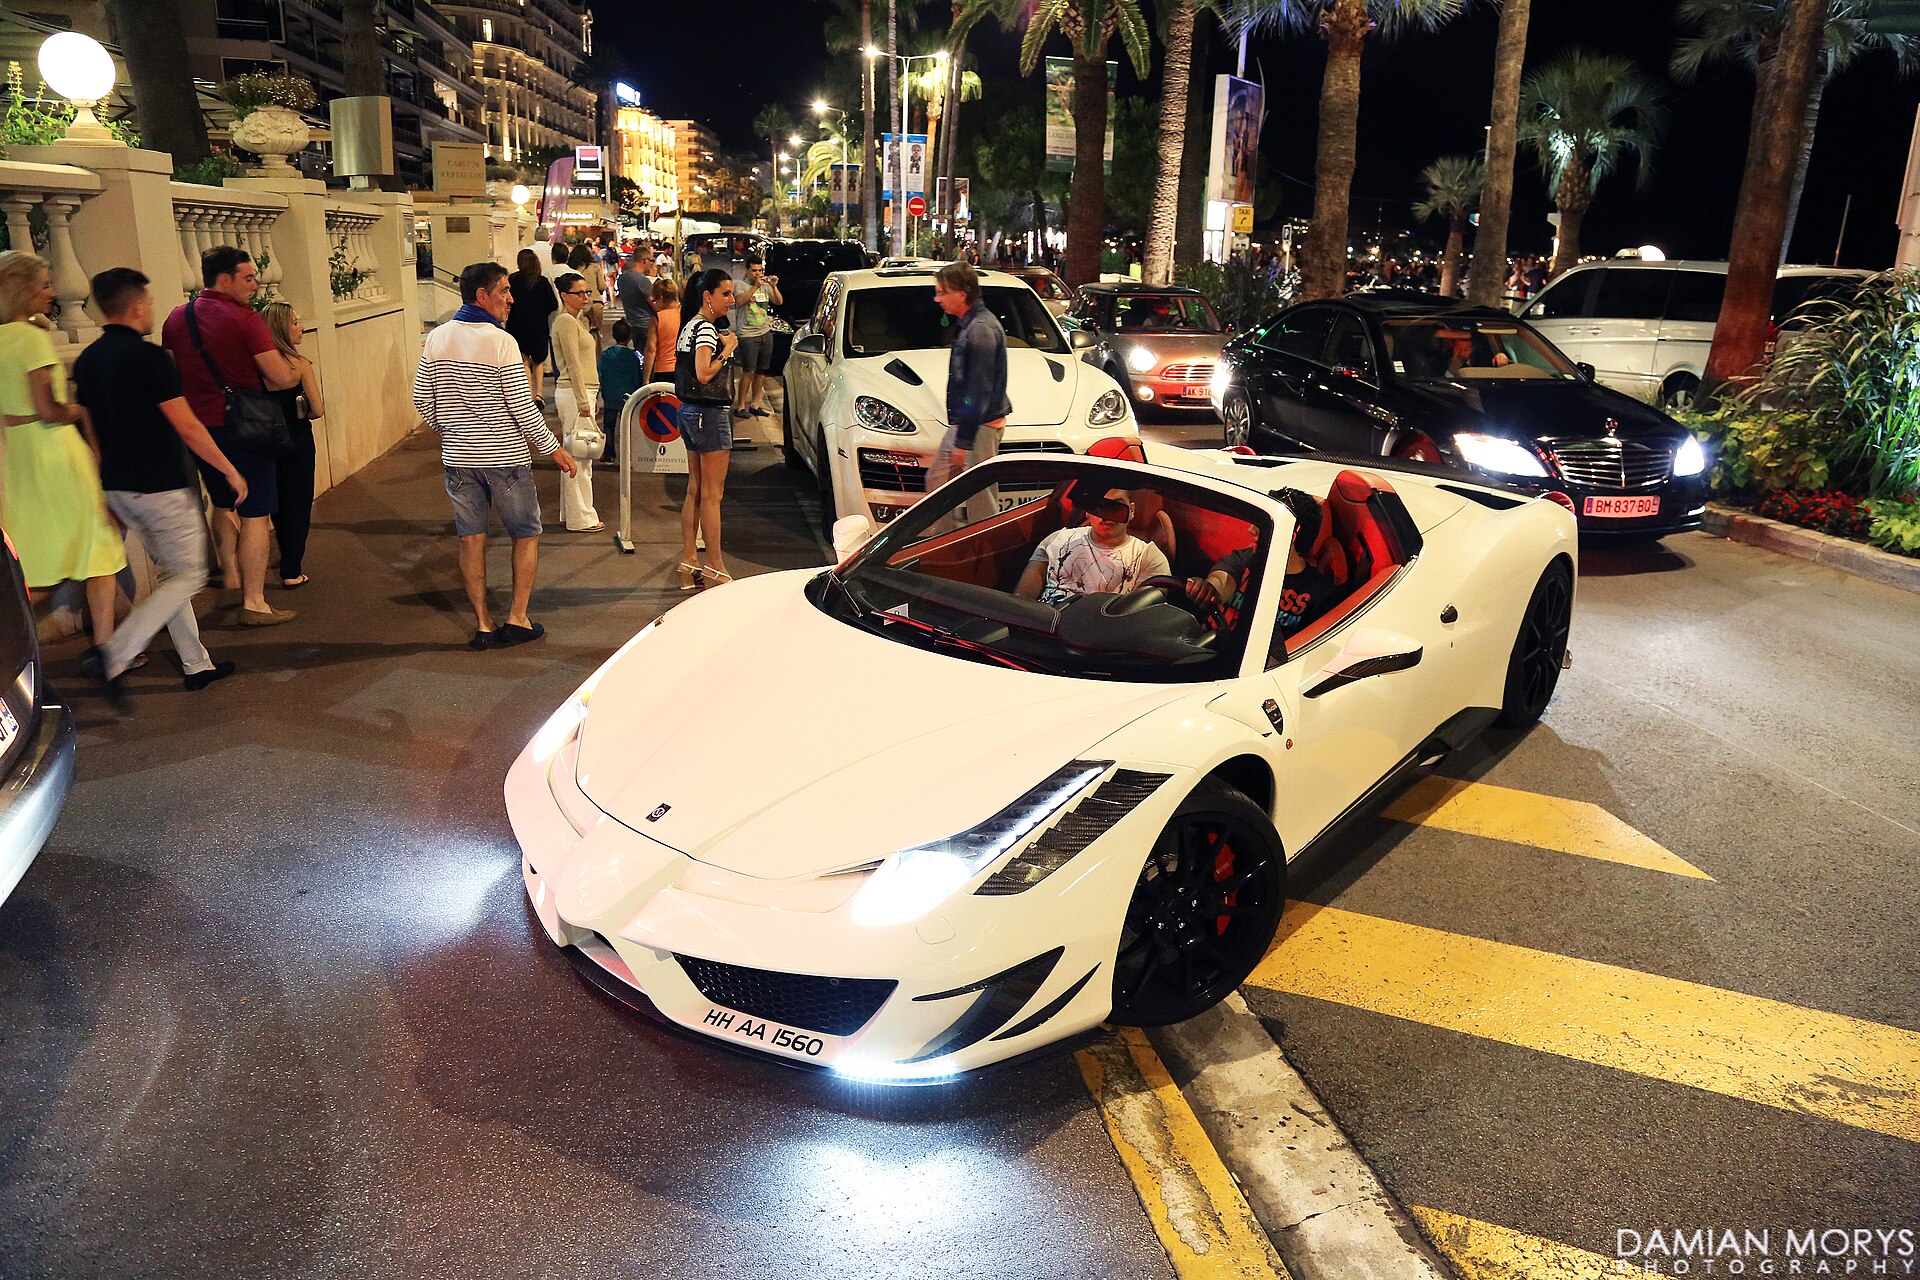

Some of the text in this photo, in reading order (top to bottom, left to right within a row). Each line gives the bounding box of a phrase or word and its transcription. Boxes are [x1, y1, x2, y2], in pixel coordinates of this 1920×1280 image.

[703, 1008, 824, 1056] HH AA 1560
